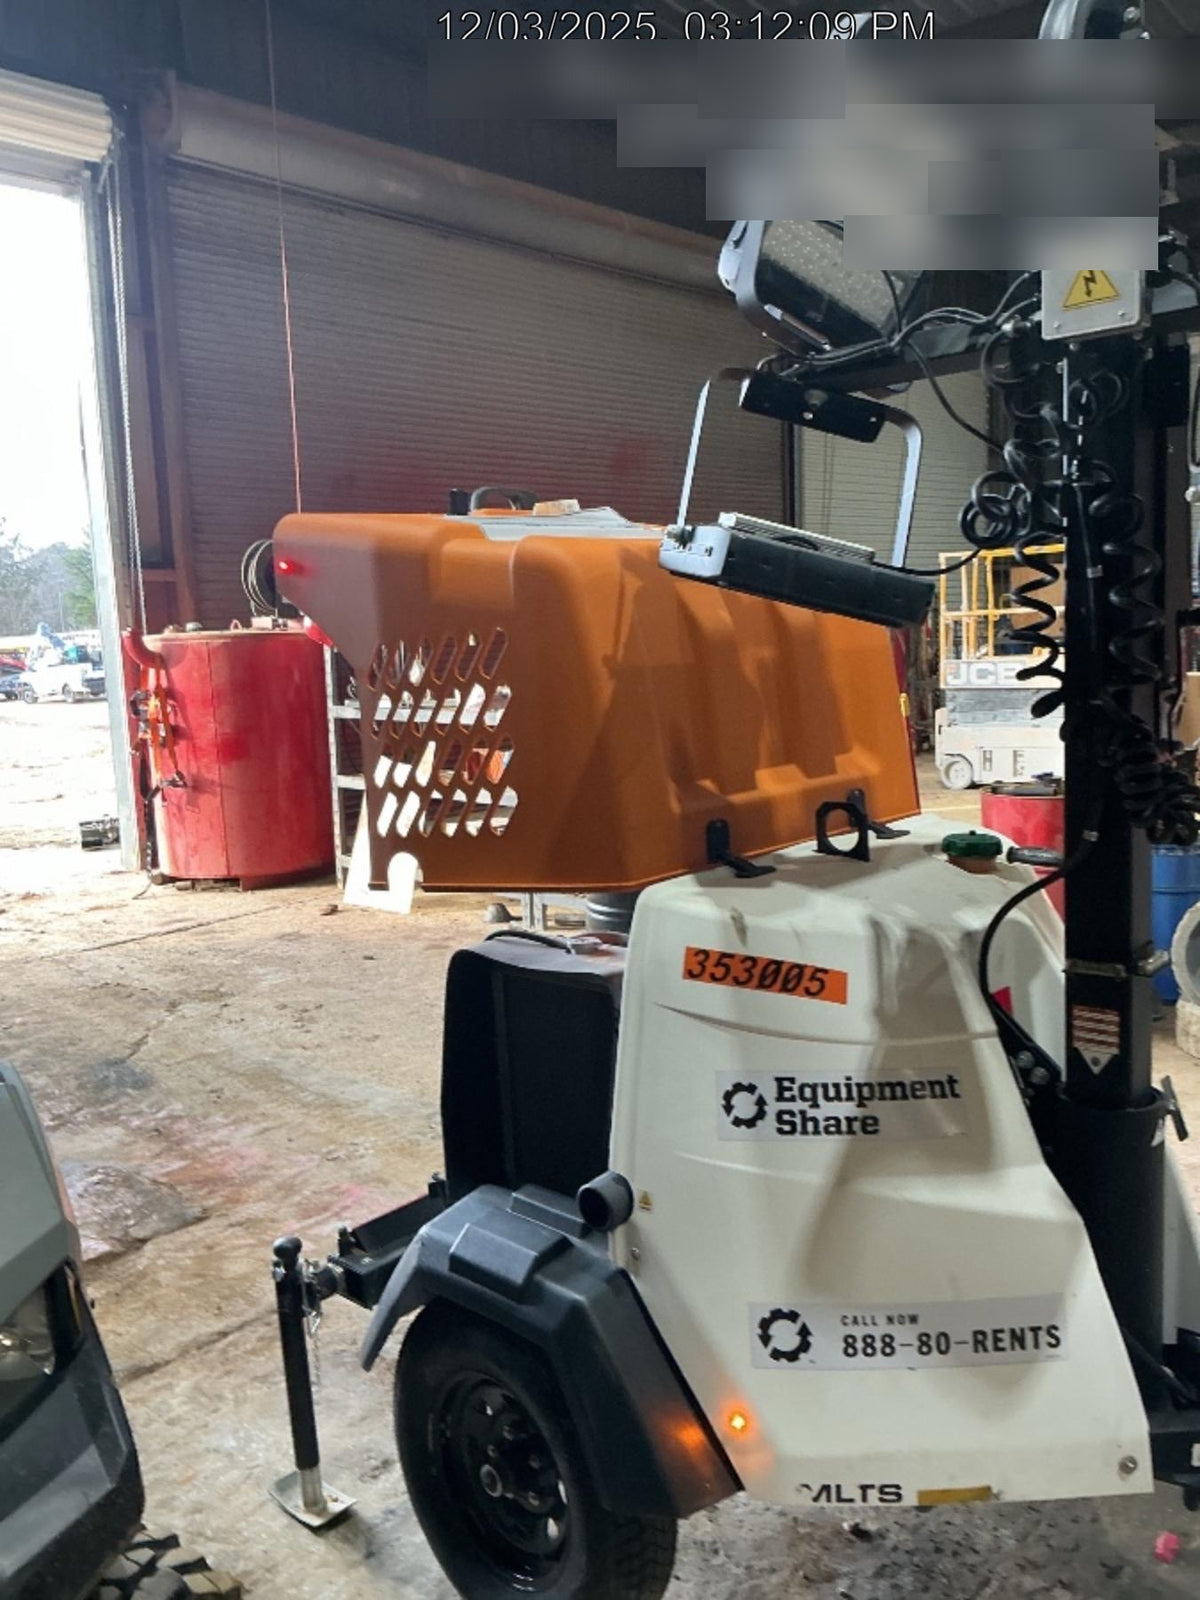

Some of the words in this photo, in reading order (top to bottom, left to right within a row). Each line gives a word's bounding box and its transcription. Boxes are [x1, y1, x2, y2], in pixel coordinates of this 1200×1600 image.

[687, 949, 829, 997] 353005
[774, 1075, 961, 1109] Equipment
[775, 1109, 880, 1136] Share
[840, 1314, 879, 1327] CALL
[886, 1313, 920, 1326] NOW
[842, 1324, 1062, 1358] 888-80-RENTS
